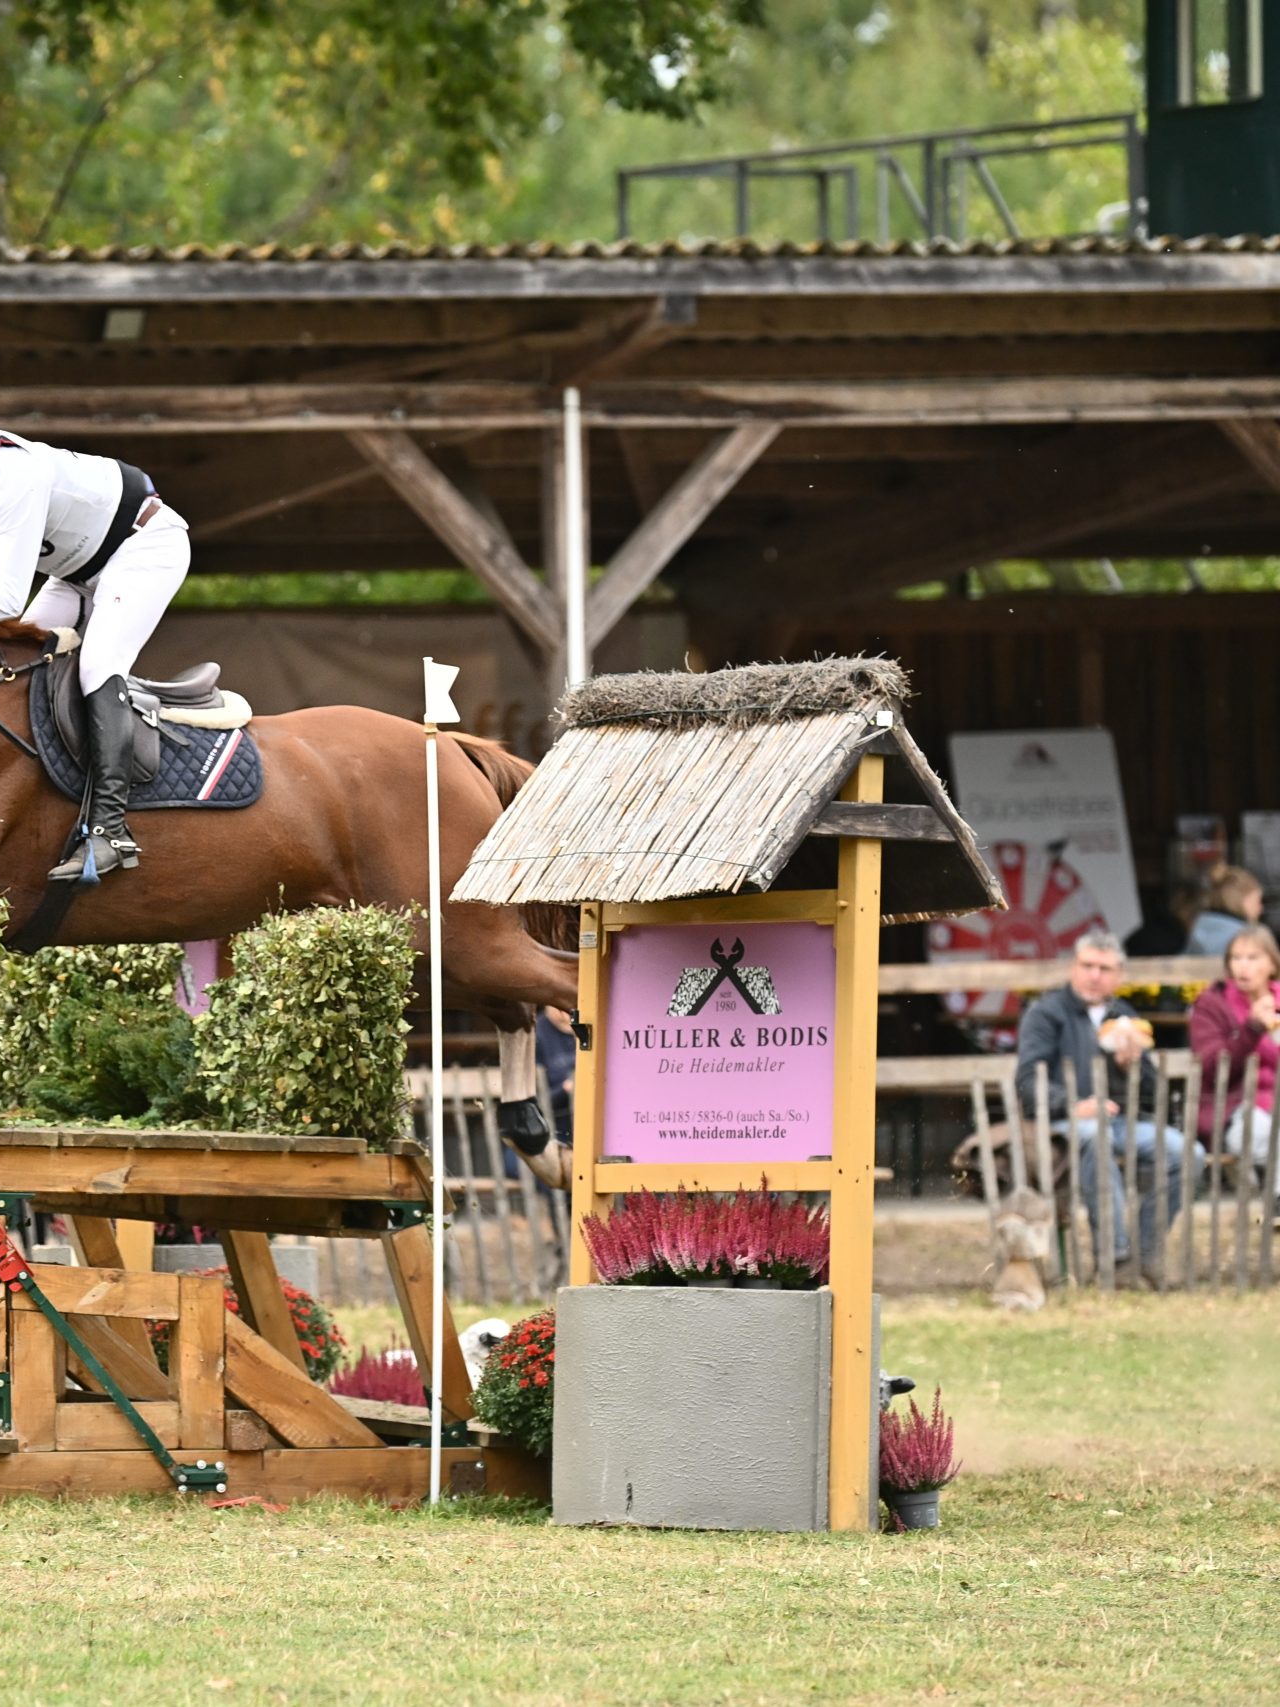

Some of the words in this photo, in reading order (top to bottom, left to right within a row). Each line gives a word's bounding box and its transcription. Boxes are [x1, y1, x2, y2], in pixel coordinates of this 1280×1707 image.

[716, 1001, 737, 1012] 1980
[622, 1024, 721, 1050] MÜLLER
[730, 1027, 746, 1048] &
[757, 1026, 829, 1047] BODIS
[657, 1058, 684, 1074] Die
[689, 1056, 786, 1074] Heidemakler
[736, 1110, 765, 1124] (auch
[658, 1125, 787, 1140] www.heidemakler.de
